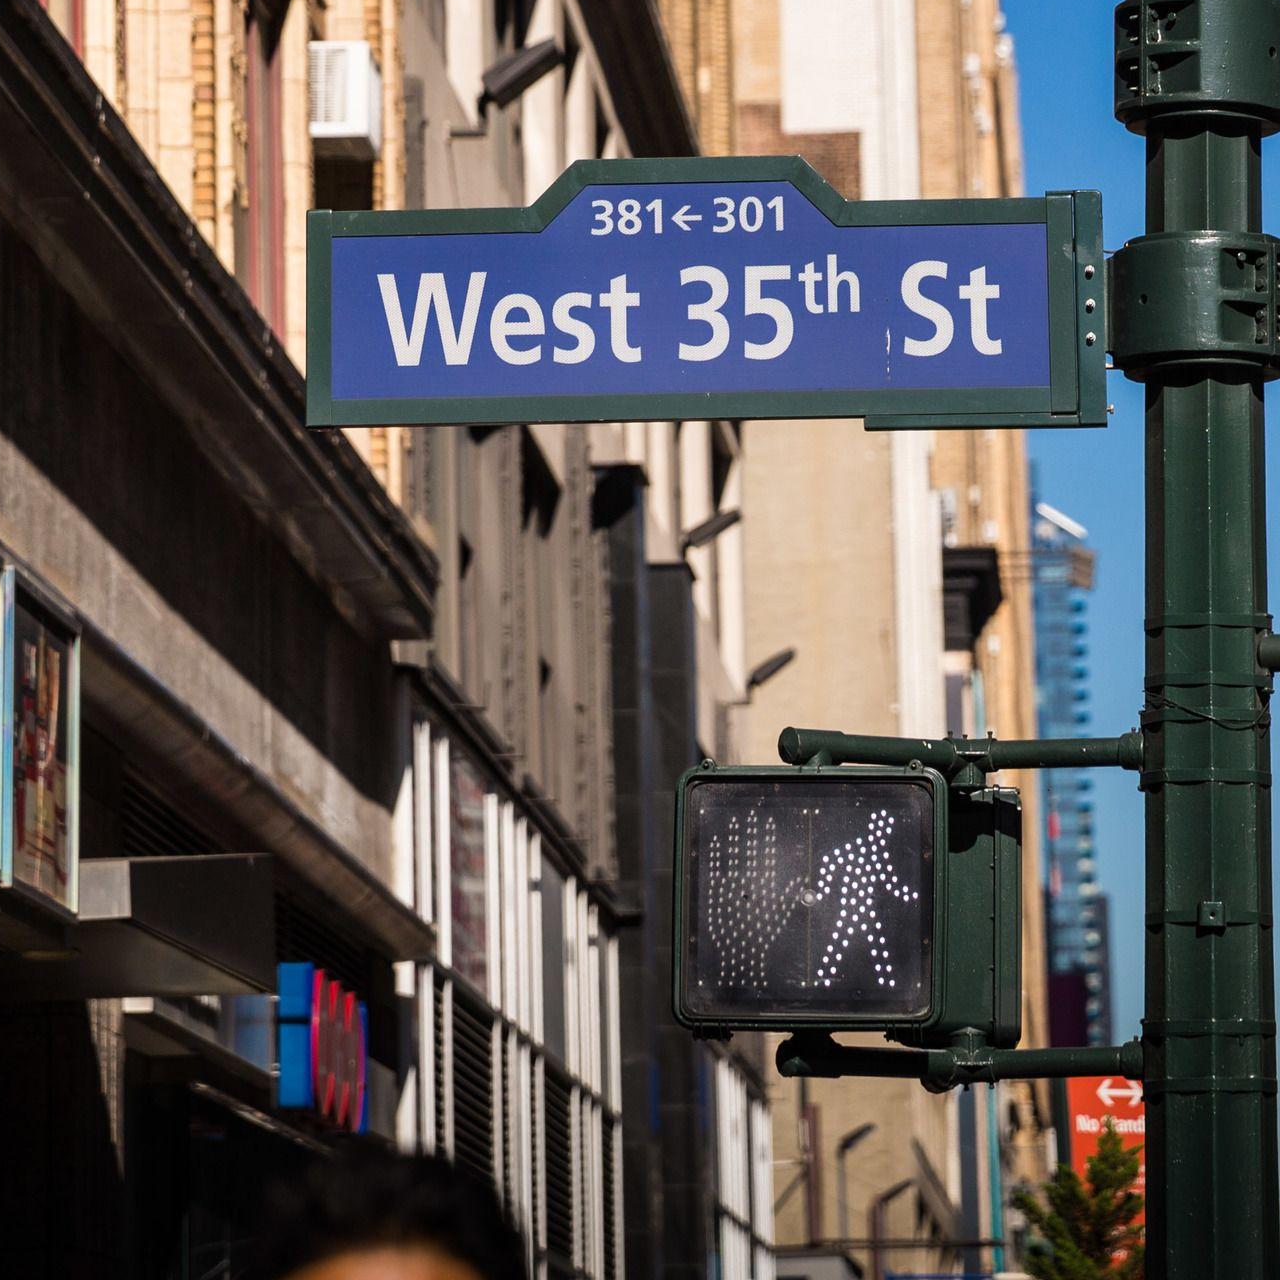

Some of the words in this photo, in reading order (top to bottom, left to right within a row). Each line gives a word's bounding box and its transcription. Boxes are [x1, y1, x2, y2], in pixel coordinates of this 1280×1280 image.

[590, 198, 664, 236] 381
[712, 195, 785, 233] 301
[376, 271, 642, 367] West
[678, 253, 861, 362] 35th
[900, 260, 1003, 357] St
[1076, 1114, 1100, 1133] No
